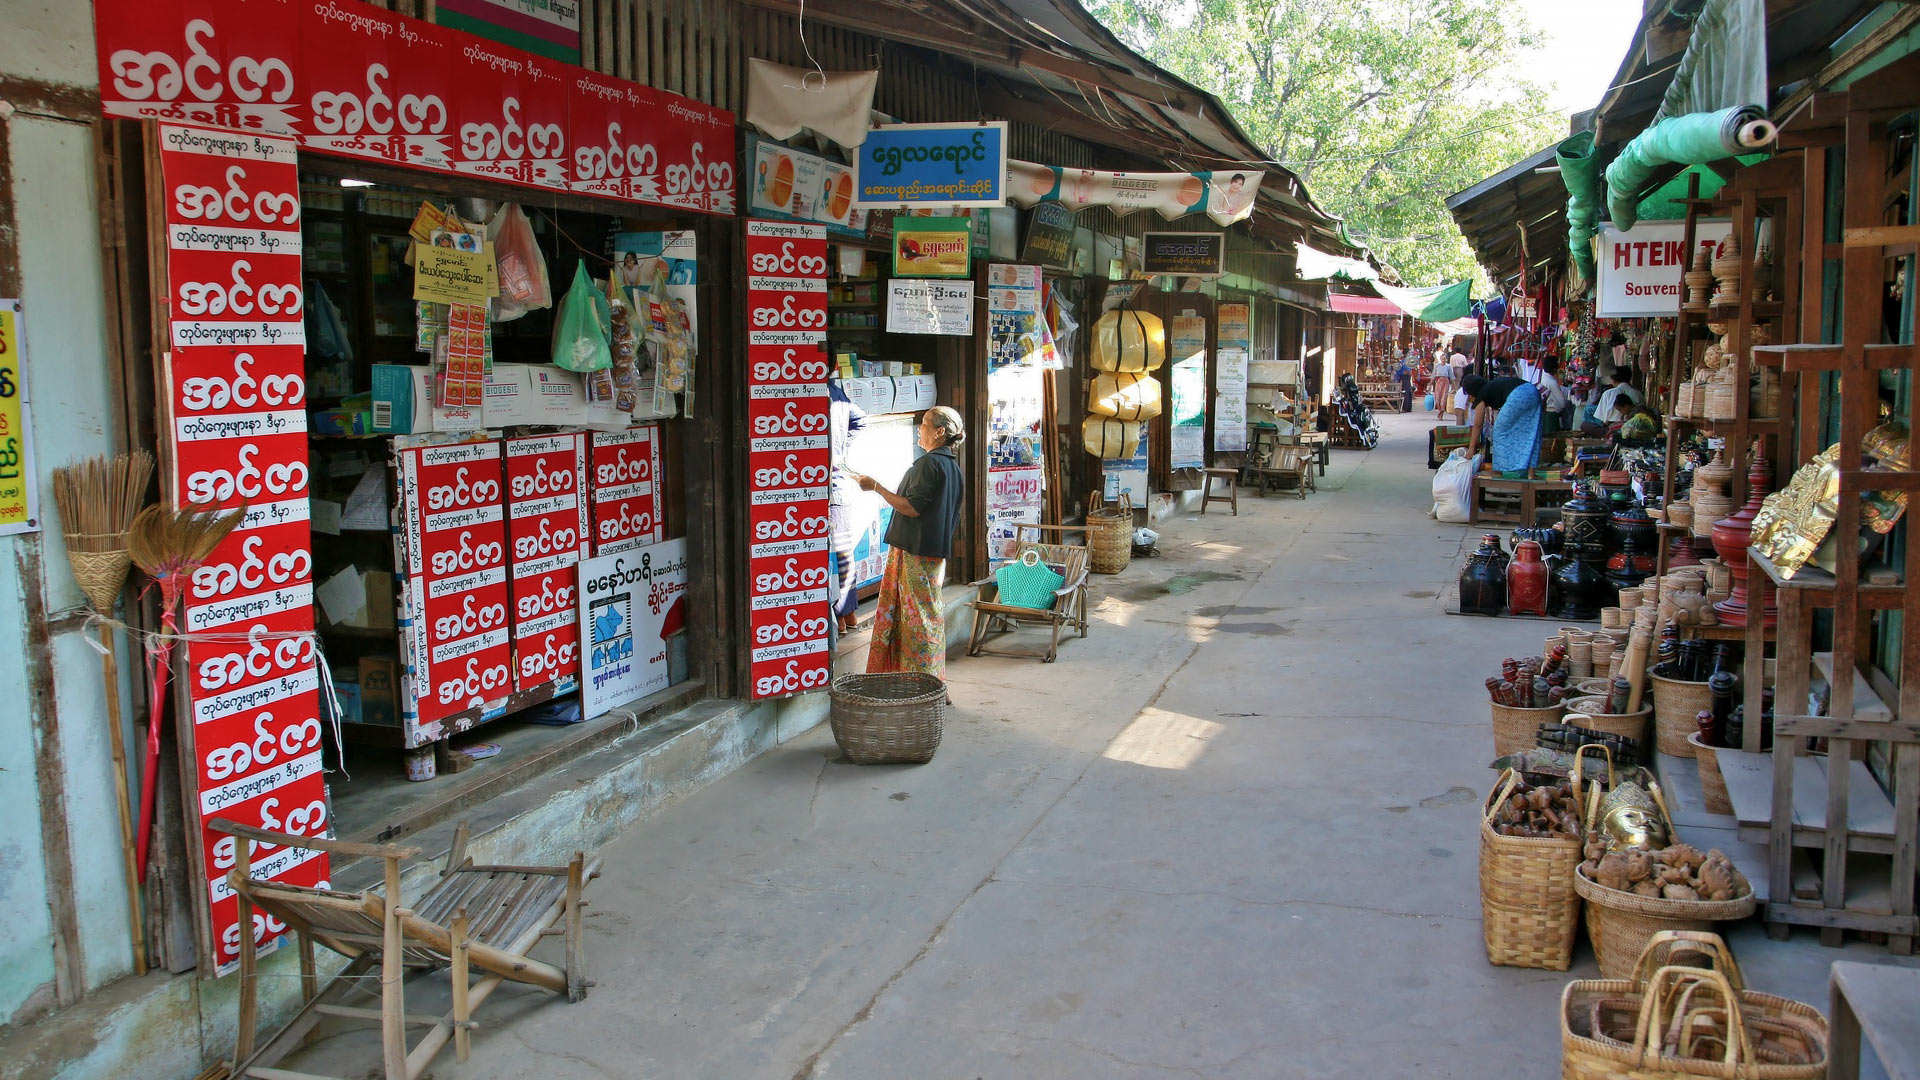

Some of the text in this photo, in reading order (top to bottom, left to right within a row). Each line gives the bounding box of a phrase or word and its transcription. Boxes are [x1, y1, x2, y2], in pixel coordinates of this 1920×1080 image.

[872, 131, 986, 176] ရွှေလရောင်
[864, 180, 992, 200] ဆေးပစ္စည်းအရောင်းဆိုင်
[1112, 178, 1158, 189] BIOGESIC
[486, 385, 518, 395] BIOGESIC
[541, 384, 573, 395] BIOGESIC
[587, 552, 652, 596] မနော်ဟရီ
